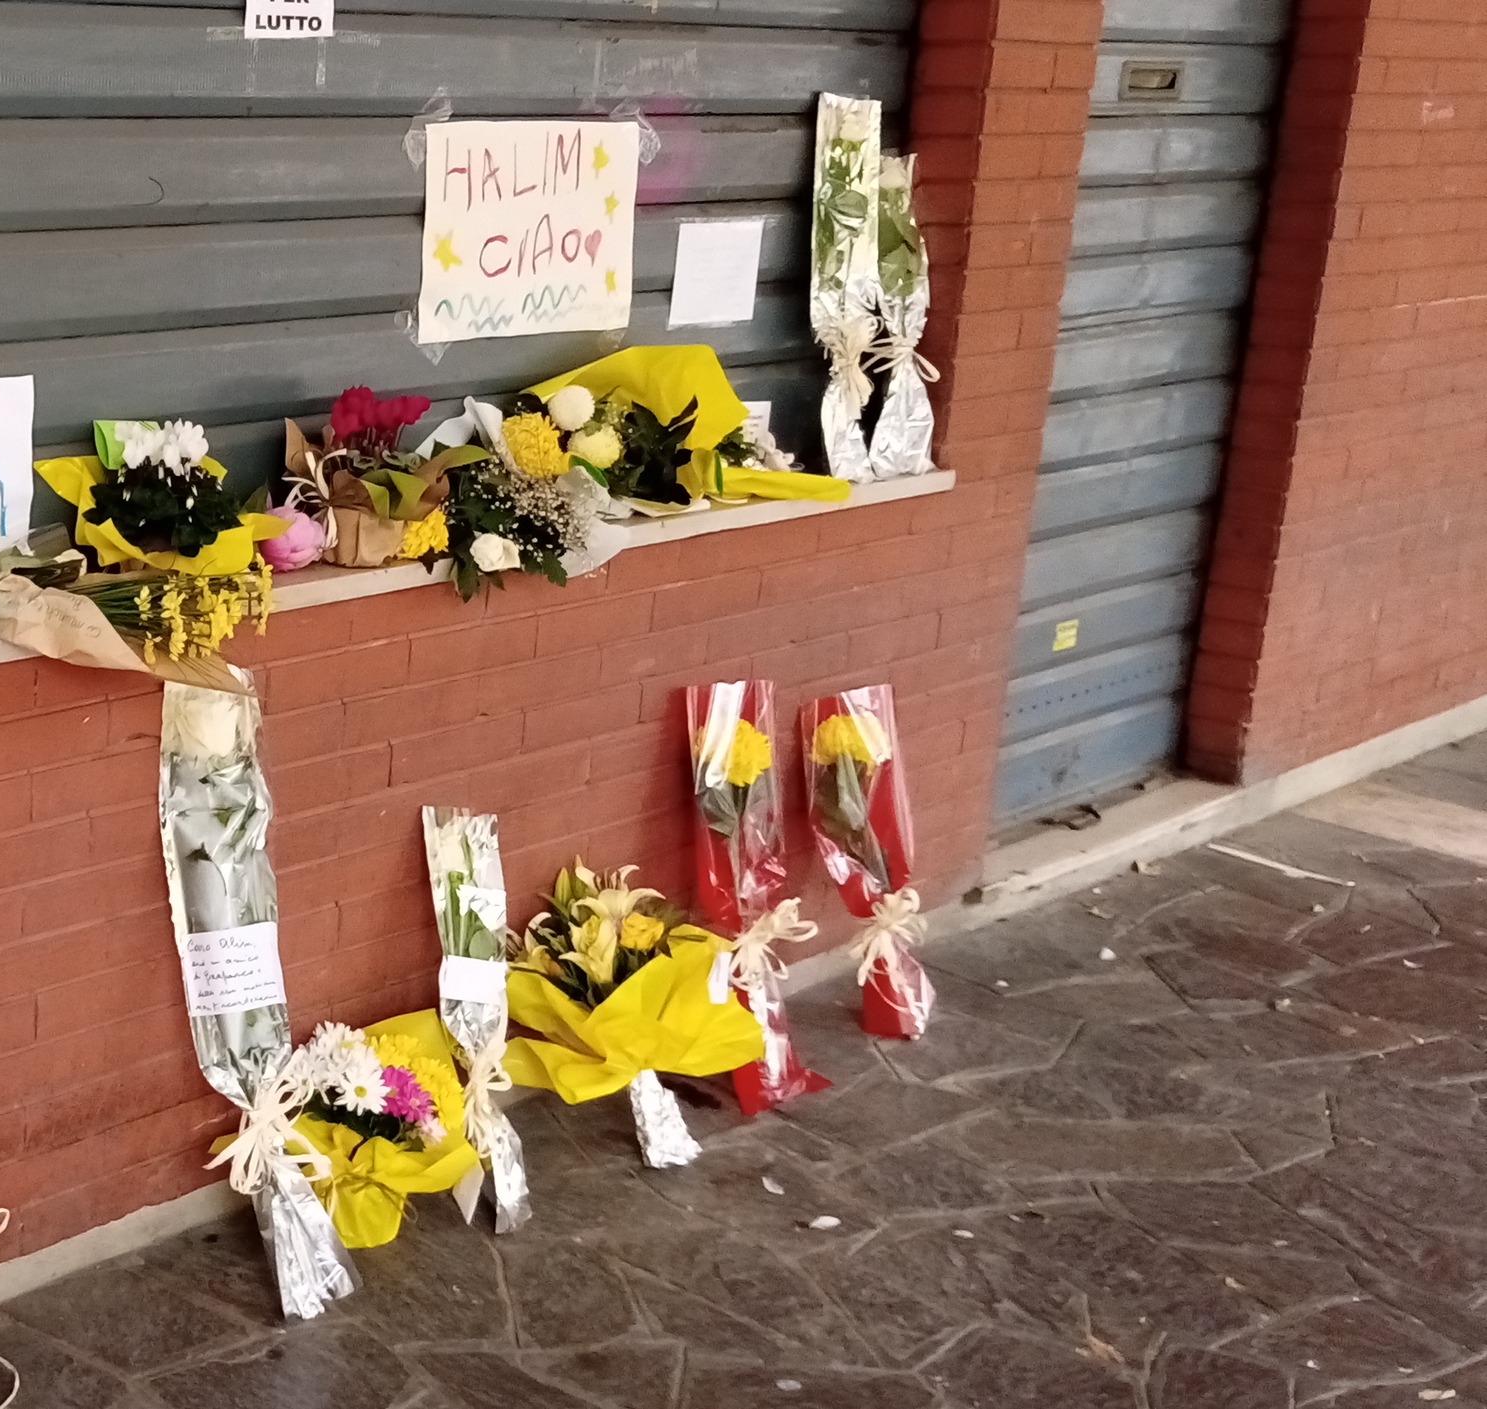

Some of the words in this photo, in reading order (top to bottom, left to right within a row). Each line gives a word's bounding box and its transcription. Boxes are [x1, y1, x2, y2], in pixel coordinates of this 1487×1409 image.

[255, 14, 322, 31] LUTTO
[443, 128, 581, 212] HALIM
[479, 213, 581, 278] CIAO
